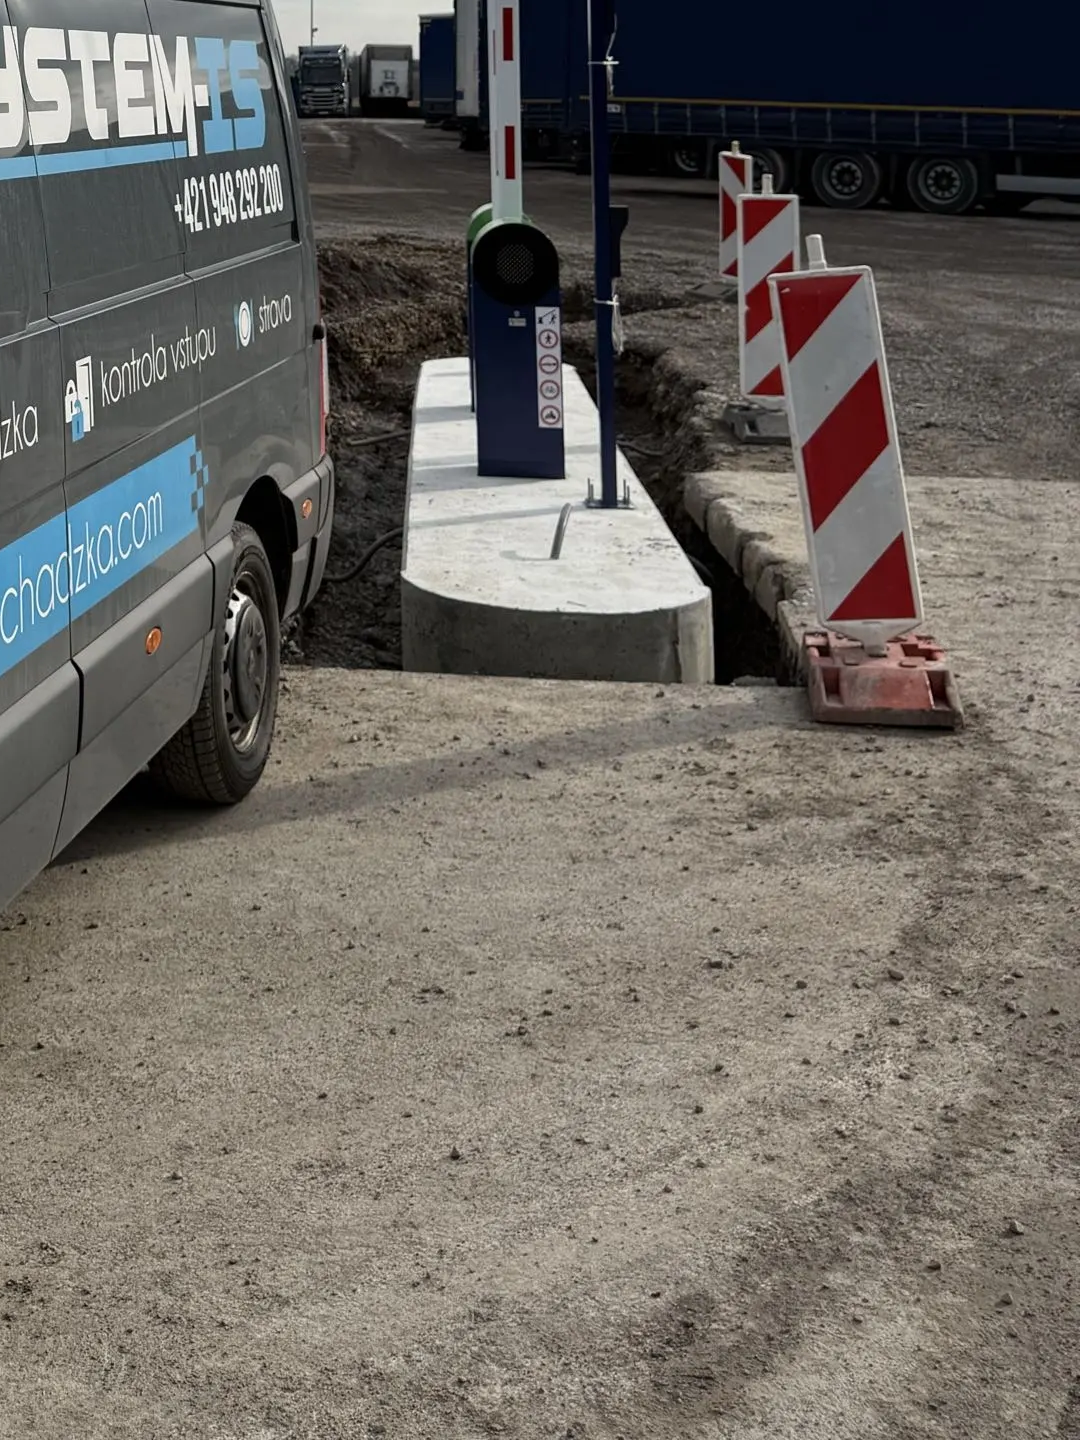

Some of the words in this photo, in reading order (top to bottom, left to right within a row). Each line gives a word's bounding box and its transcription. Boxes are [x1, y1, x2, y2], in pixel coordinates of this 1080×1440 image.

[174, 176, 211, 233] +421
[209, 173, 237, 227] 948
[235, 167, 262, 220] 292
[259, 163, 283, 214] 200
[258, 294, 292, 334] strava
[100, 333, 168, 408] kontrola
[169, 325, 217, 374] vstupu
